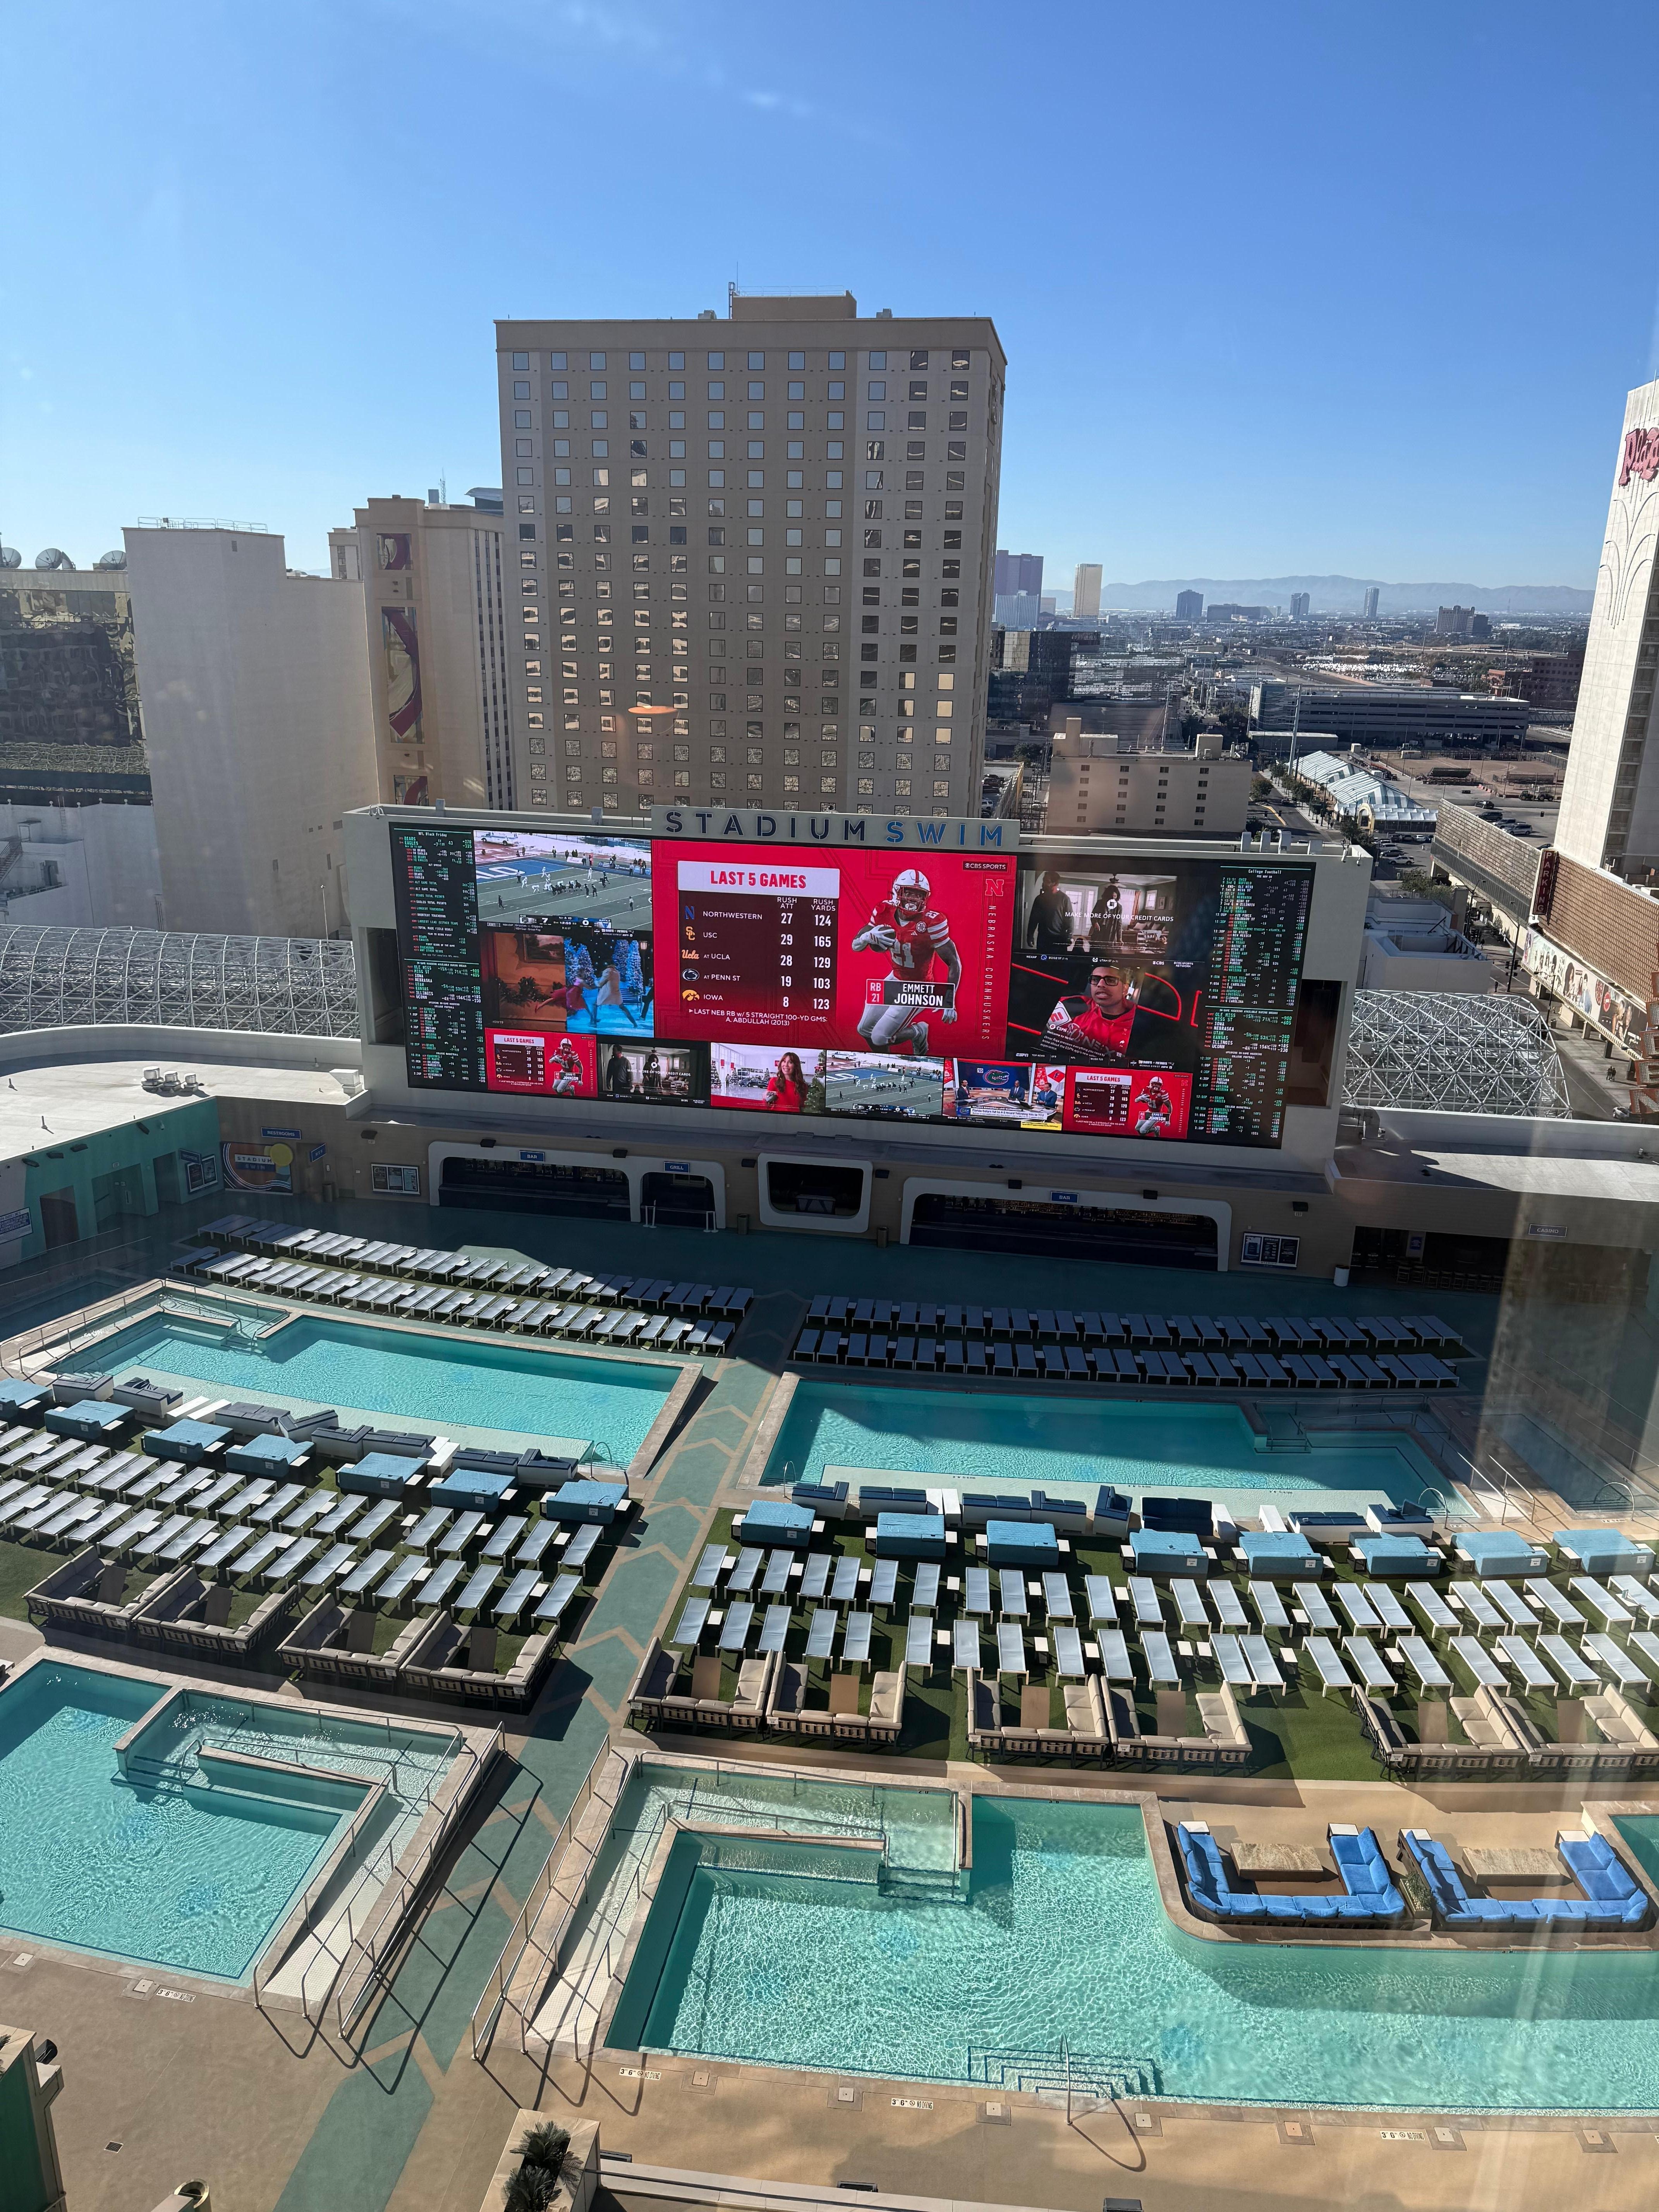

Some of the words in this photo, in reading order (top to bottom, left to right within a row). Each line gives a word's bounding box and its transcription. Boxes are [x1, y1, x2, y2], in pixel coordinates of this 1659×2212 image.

[666, 811, 866, 842] STADIUM
[886, 821, 1003, 847] SWIM
[711, 871, 744, 885] LAST
[749, 872, 756, 886] 5
[760, 873, 806, 889] GAMES
[1537, 852, 1552, 911] PARKING
[703, 911, 763, 920] NORTHWESTERN
[781, 913, 793, 924] 27
[815, 915, 831, 926] 124
[986, 905, 996, 959] NEBRASKA
[781, 934, 793, 945] 29
[814, 936, 831, 947] 165
[780, 955, 792, 966] 28
[814, 957, 831, 968] 129
[891, 943, 915, 968] 21
[781, 976, 792, 987] 19
[813, 978, 830, 989] 103
[871, 982, 881, 992] RB
[903, 983, 935, 994] EMMETT
[783, 996, 789, 1007] 8
[813, 998, 830, 1010] 123
[871, 993, 879, 1003] 21
[894, 993, 943, 1006] JOHNSON
[982, 968, 993, 1040] CORNHUSKERS
